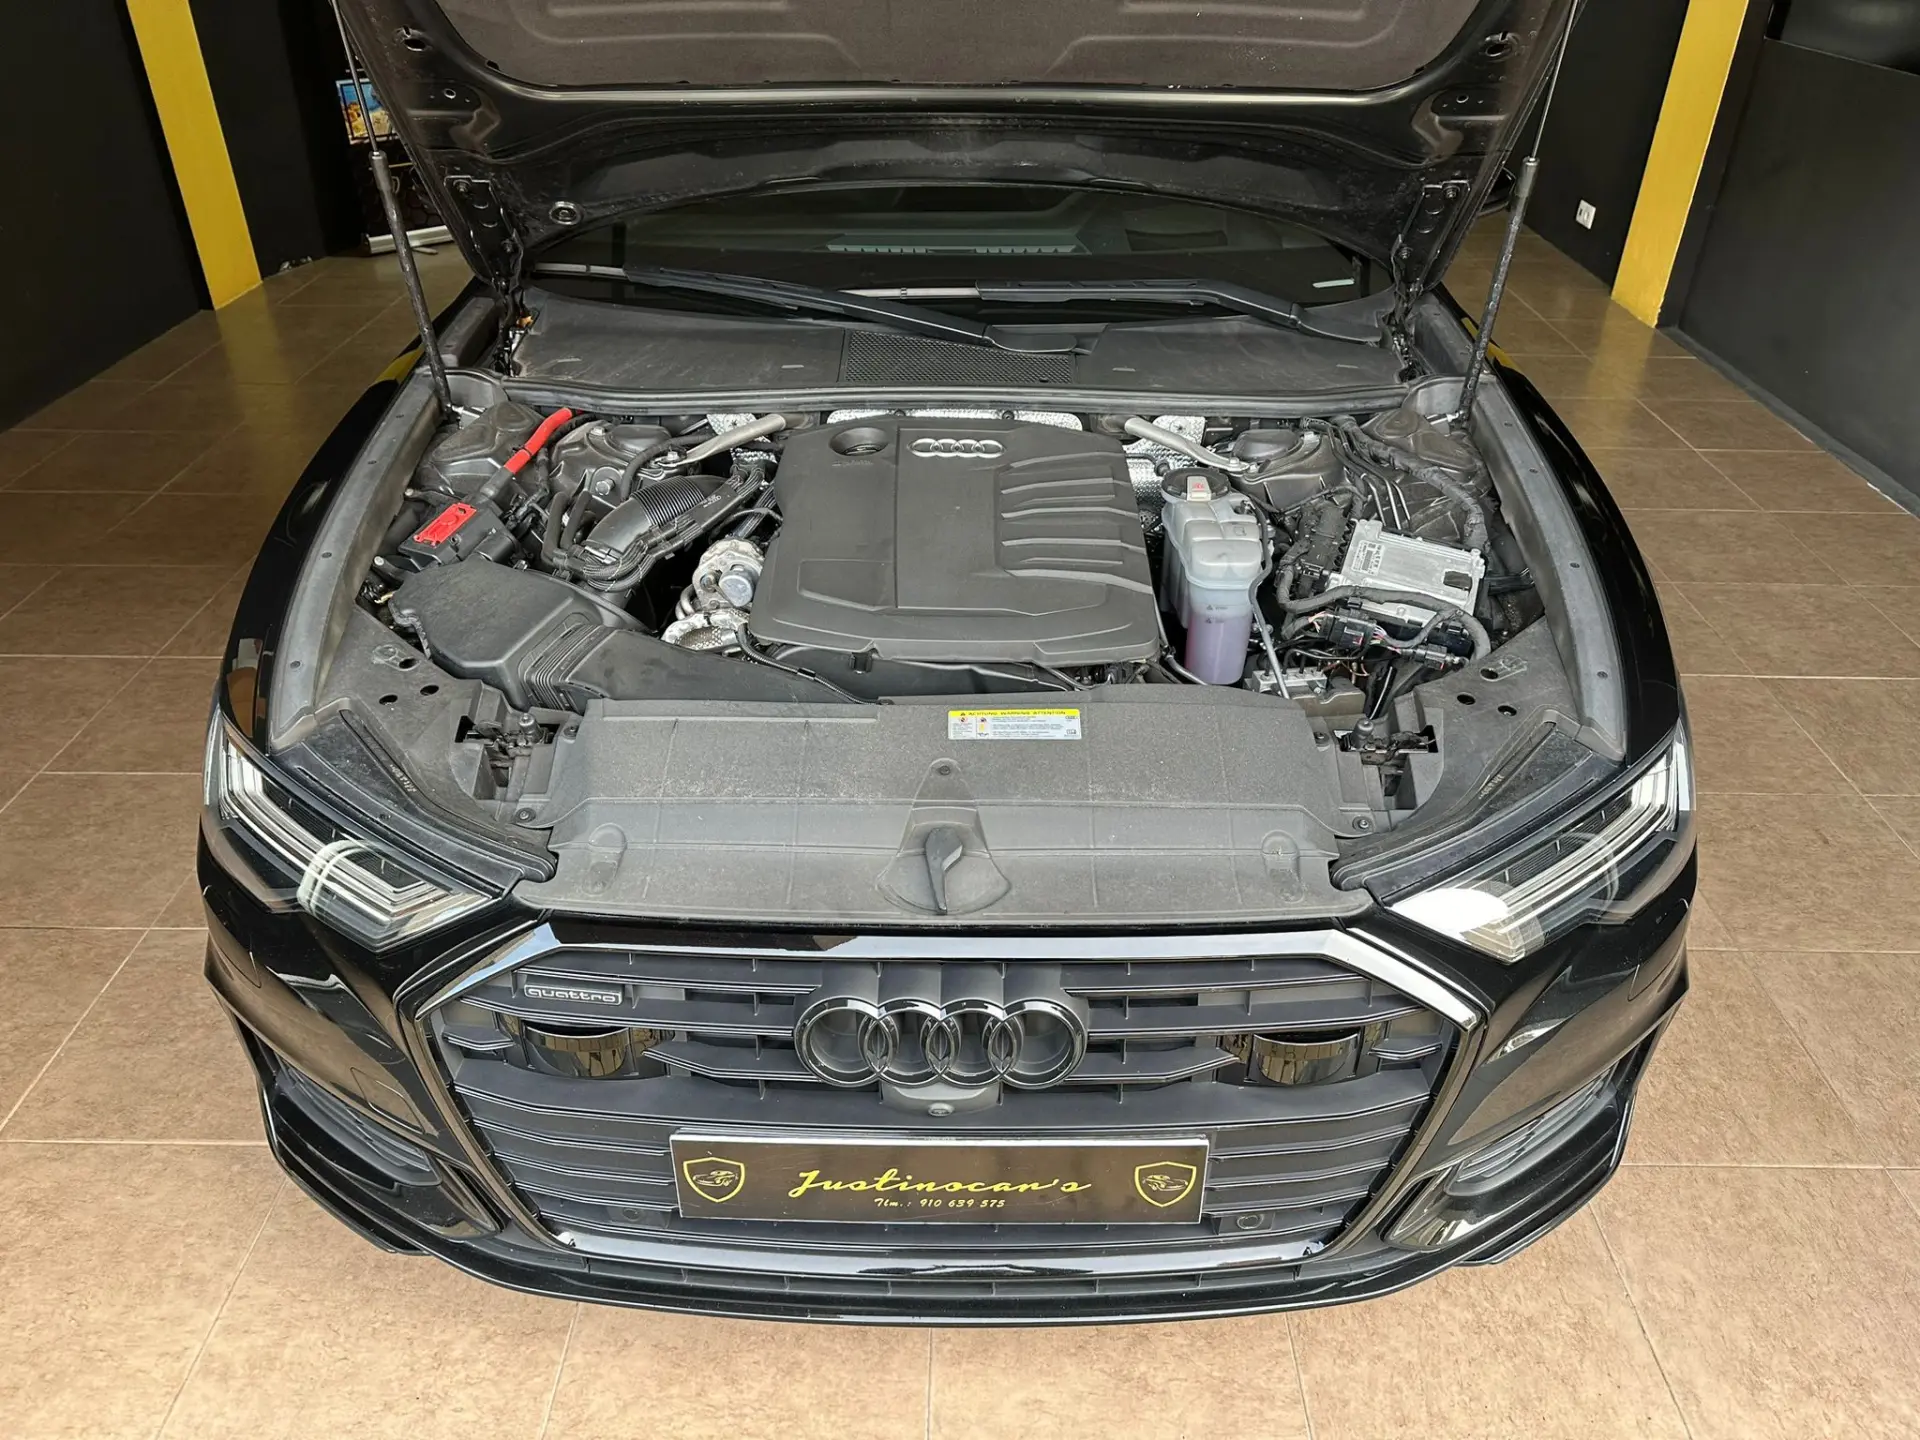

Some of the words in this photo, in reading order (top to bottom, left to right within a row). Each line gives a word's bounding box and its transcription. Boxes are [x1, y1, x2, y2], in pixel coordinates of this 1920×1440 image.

[528, 988, 616, 1003] quattro
[787, 1168, 1092, 1198] Justinocar's
[920, 1198, 942, 1208] 910
[948, 1198, 975, 1208] 639
[980, 1199, 1006, 1208] 575
